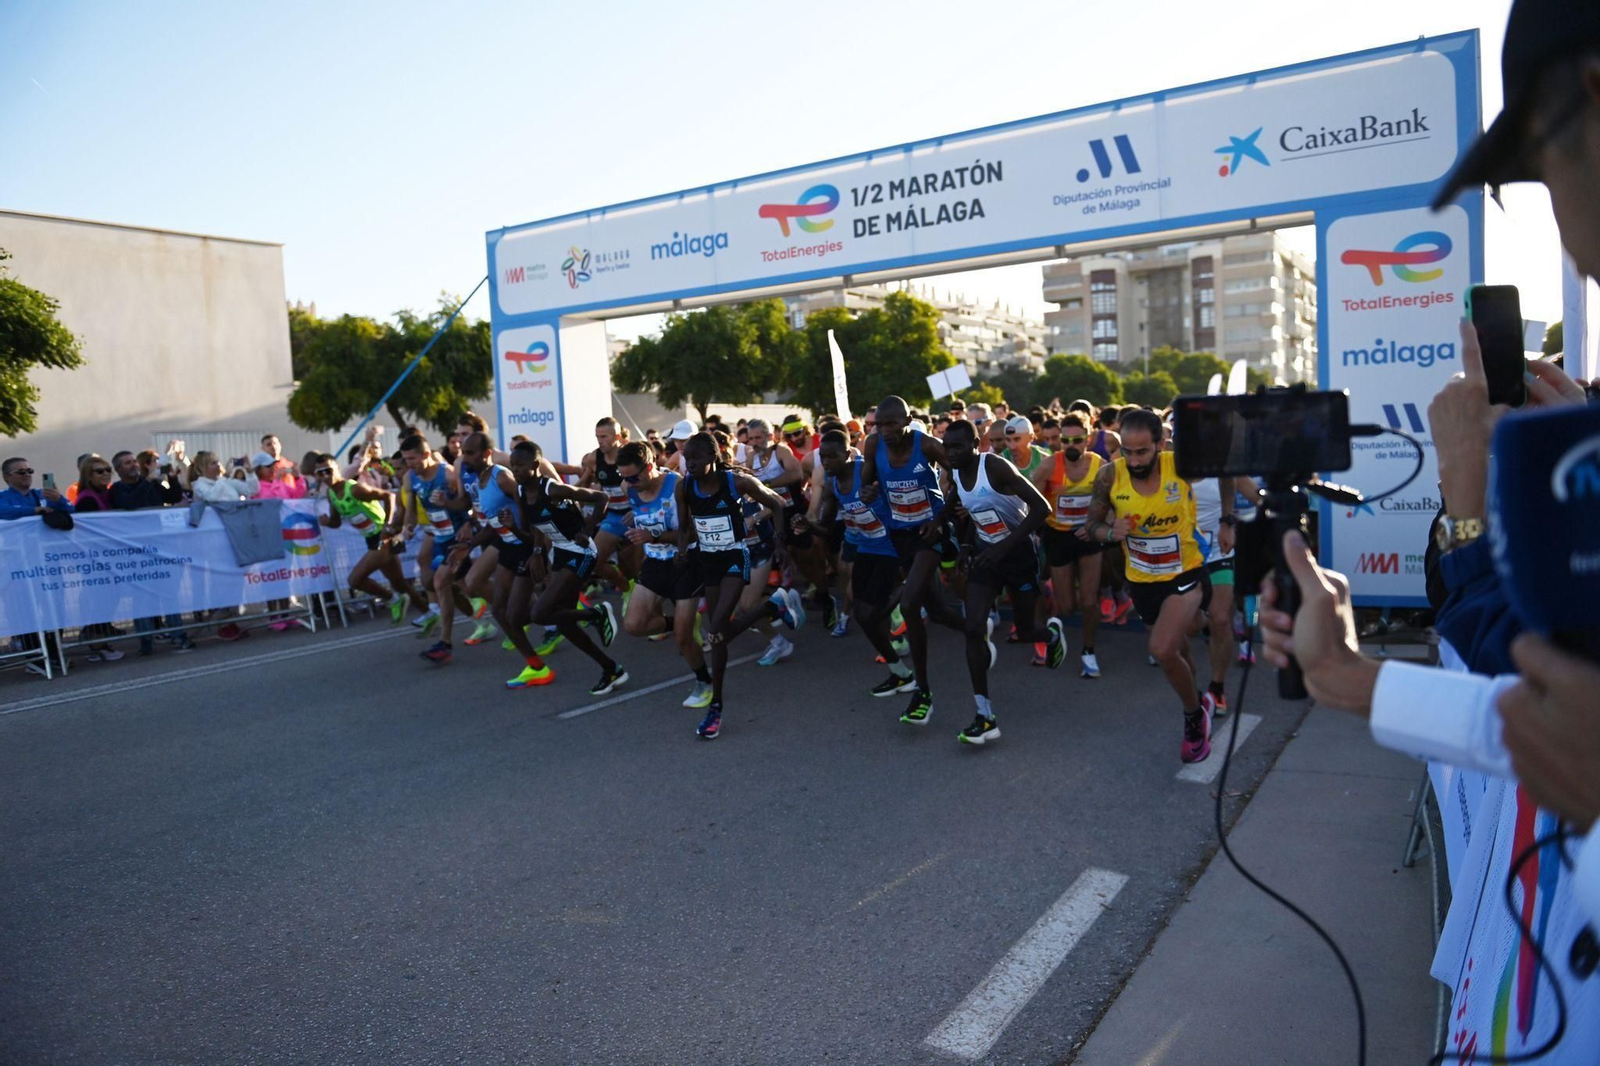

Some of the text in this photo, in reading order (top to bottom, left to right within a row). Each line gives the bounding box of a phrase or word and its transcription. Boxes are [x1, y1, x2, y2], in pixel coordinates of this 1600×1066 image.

[1279, 107, 1430, 153] CaixaBank
[850, 159, 1004, 207] 1/2 MARATÓN
[1052, 177, 1172, 206] Diputación Provincial
[1081, 197, 1142, 215] de Málaga
[852, 198, 986, 238] DE MÁLAGA
[760, 240, 843, 263] TotalEnergies
[1341, 291, 1454, 312] TotalEnergies
[1380, 497, 1441, 511] CaixaBa
[44, 551, 86, 562] Somos
[89, 549, 99, 558] la
[11, 556, 193, 581] multienergías que patrocina
[41, 570, 171, 592] tus carreras preferidas
